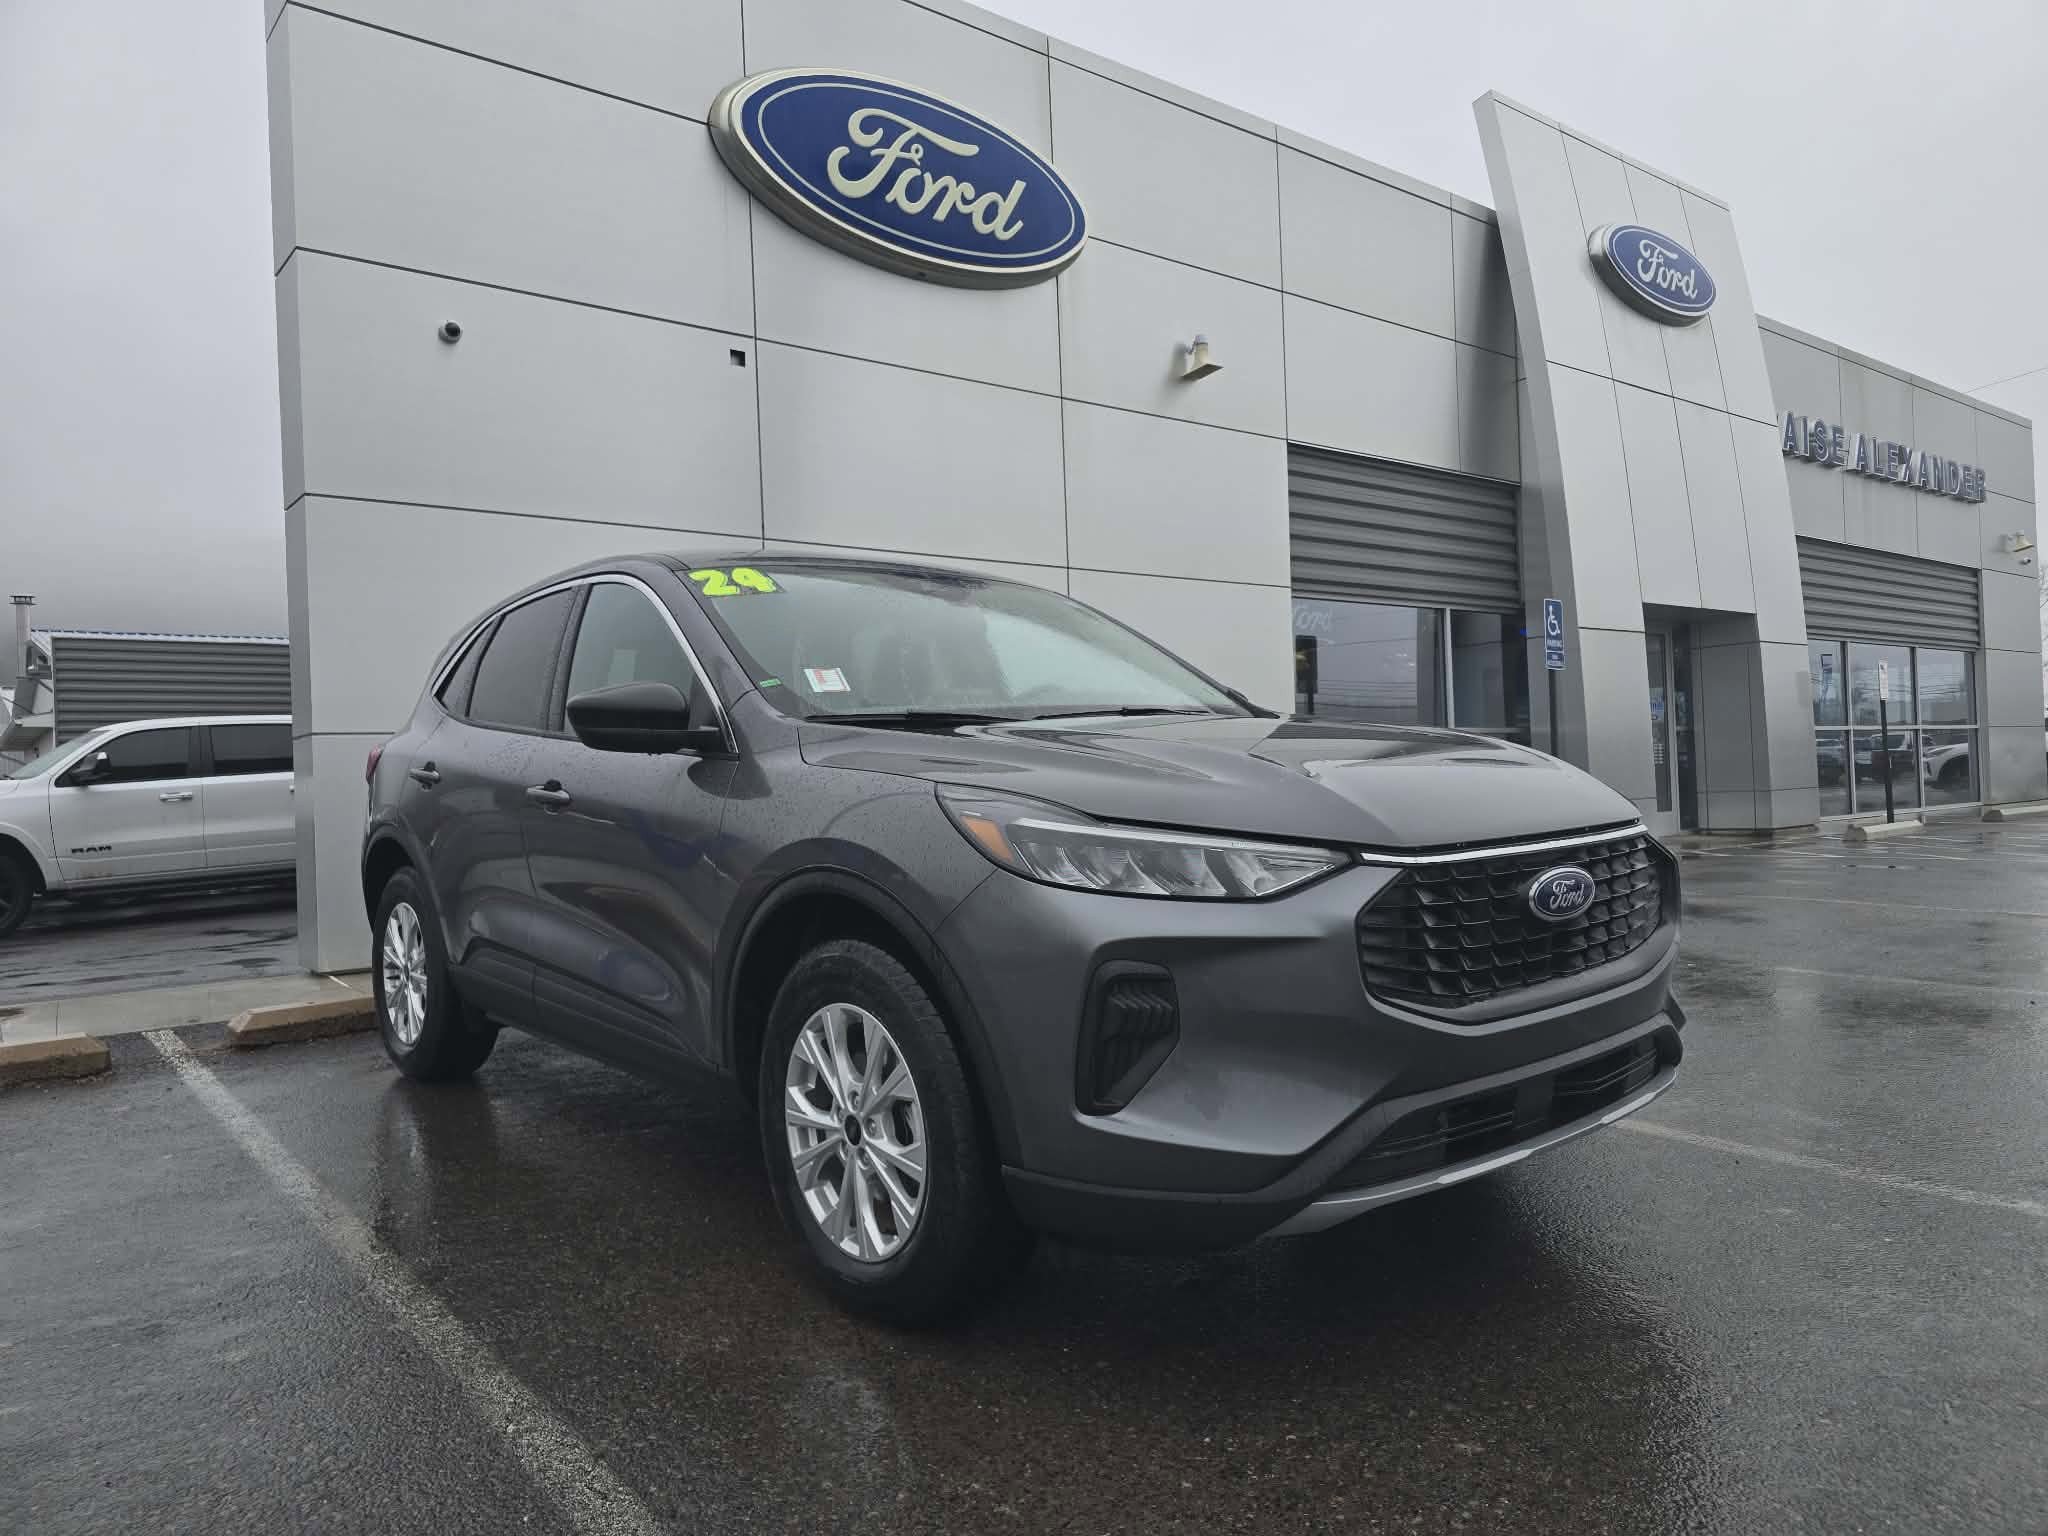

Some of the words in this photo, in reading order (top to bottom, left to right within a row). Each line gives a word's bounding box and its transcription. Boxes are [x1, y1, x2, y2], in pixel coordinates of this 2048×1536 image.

[827, 108, 1026, 240] Ford
[1637, 239, 1698, 299] Ford
[1855, 432, 1986, 501] ALEXANDER
[71, 845, 112, 853] RAM
[1549, 880, 1585, 910] Ford
